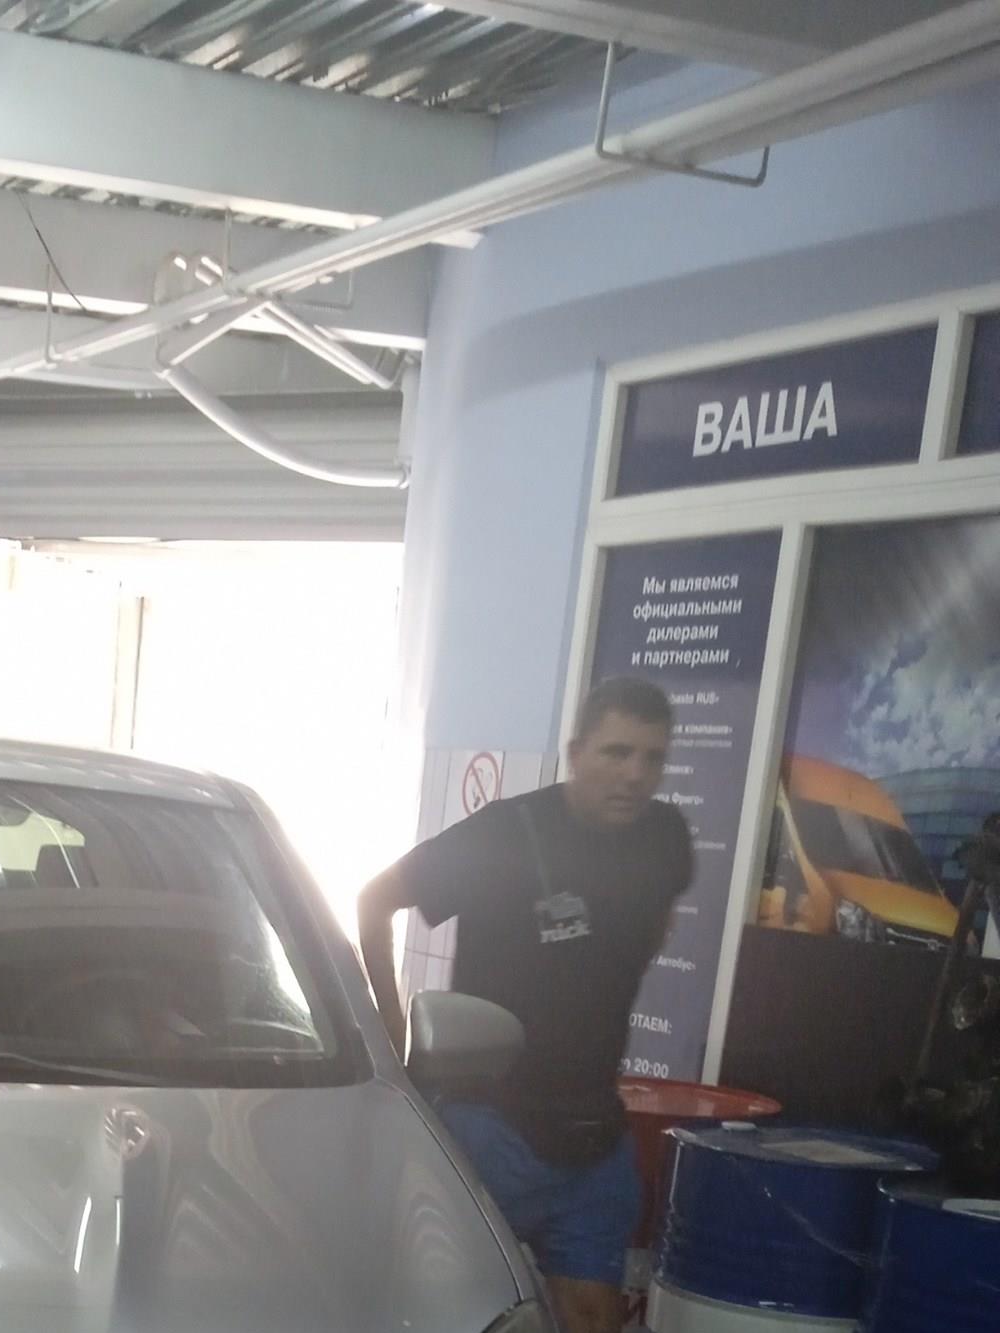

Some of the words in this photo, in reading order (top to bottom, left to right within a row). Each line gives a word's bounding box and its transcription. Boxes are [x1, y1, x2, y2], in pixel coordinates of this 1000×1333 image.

[692, 381, 838, 457] ВАША
[642, 576, 666, 595] Мы
[669, 574, 739, 593] являемся
[632, 599, 743, 622] официальными
[646, 625, 719, 644] дилерами
[631, 651, 641, 667] и
[643, 649, 730, 669] партнерами
[629, 1012, 673, 1034] ОТАЕМ:
[633, 1058, 669, 1079] 20:00
